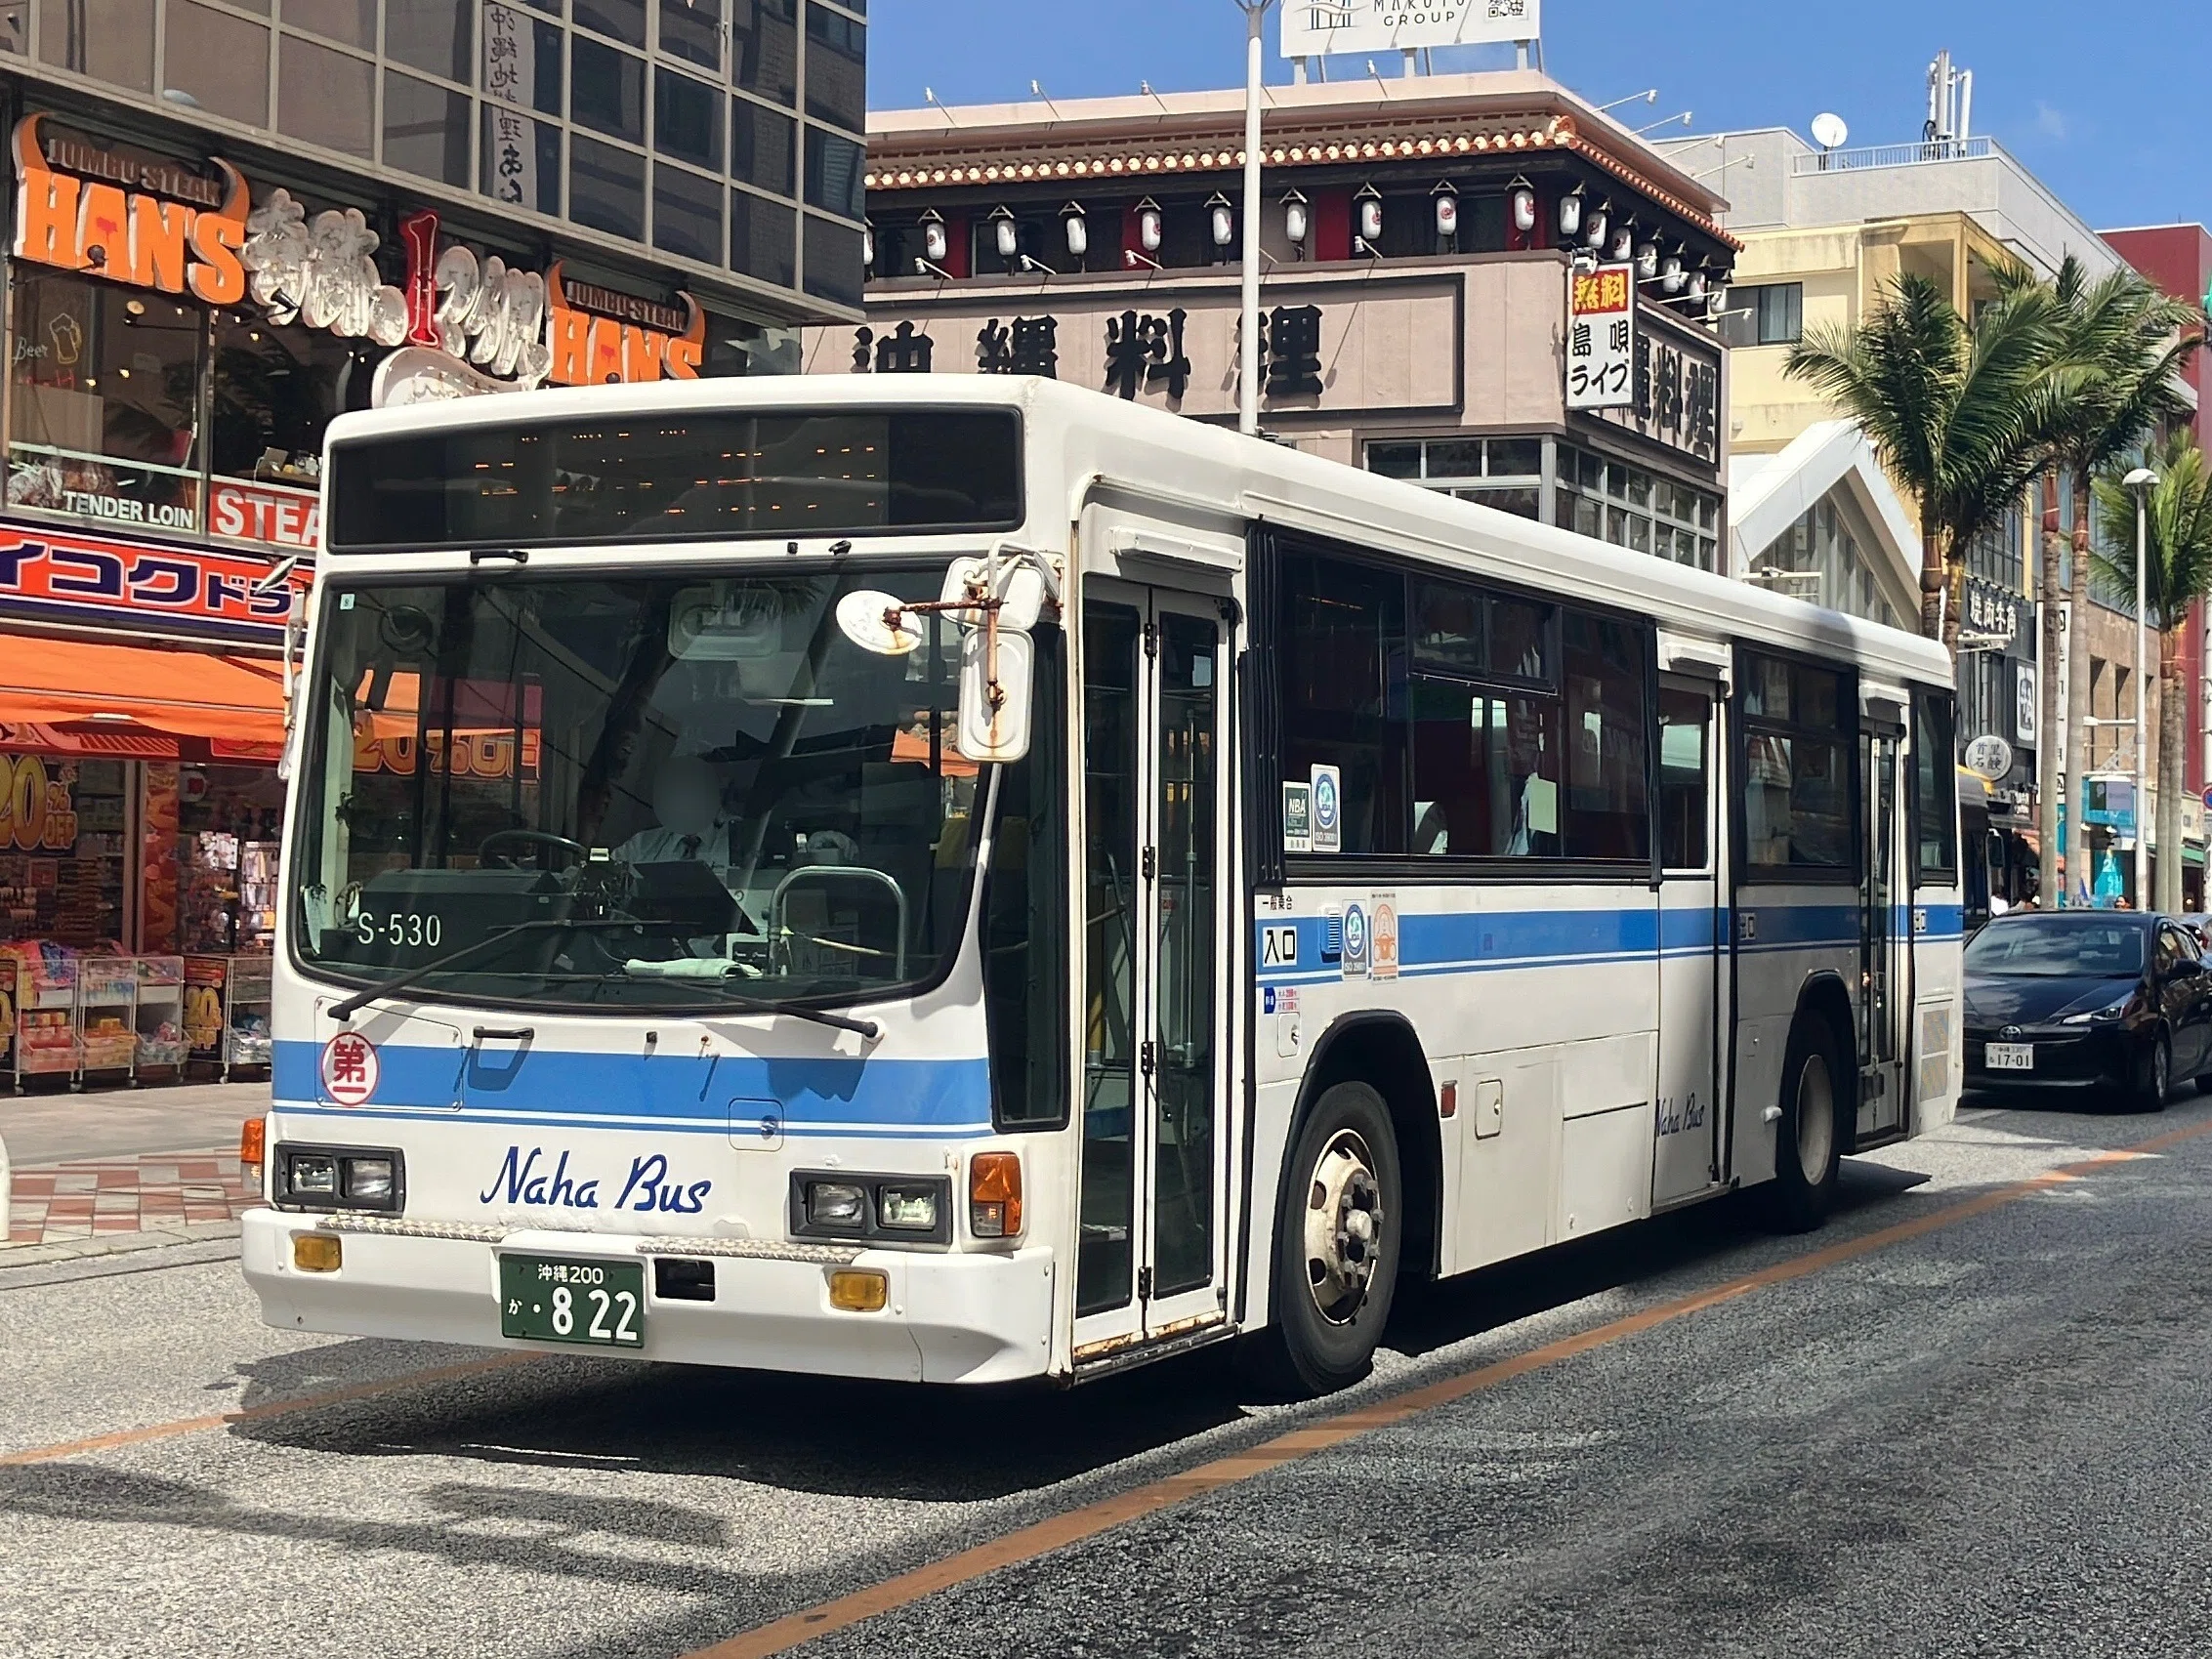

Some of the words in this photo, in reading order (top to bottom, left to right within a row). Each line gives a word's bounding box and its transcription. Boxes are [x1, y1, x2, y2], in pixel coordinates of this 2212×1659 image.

[1373, 0, 1466, 12] MAKUO
[1383, 11, 1455, 26] GROUP
[14, 165, 246, 305] HAN'S
[1573, 272, 1626, 311] 無料
[12, 336, 49, 366] Beer
[853, 304, 1324, 401] 沖縄料理
[1571, 319, 1629, 357] 島唄
[1570, 357, 1630, 396] ライブ
[62, 490, 144, 522] TENDER
[147, 505, 193, 529] LOIN
[1288, 798, 1307, 814] NBA
[356, 910, 442, 948] S-530
[1264, 930, 1296, 964] 入口
[332, 1039, 367, 1095] 第一
[1654, 1098, 1680, 1138] Naha
[1681, 1092, 1705, 1132] Bus
[480, 1144, 600, 1209] Naha
[614, 1153, 712, 1214] Bus
[537, 1263, 605, 1285] 沖縄200
[508, 1298, 522, 1315] か
